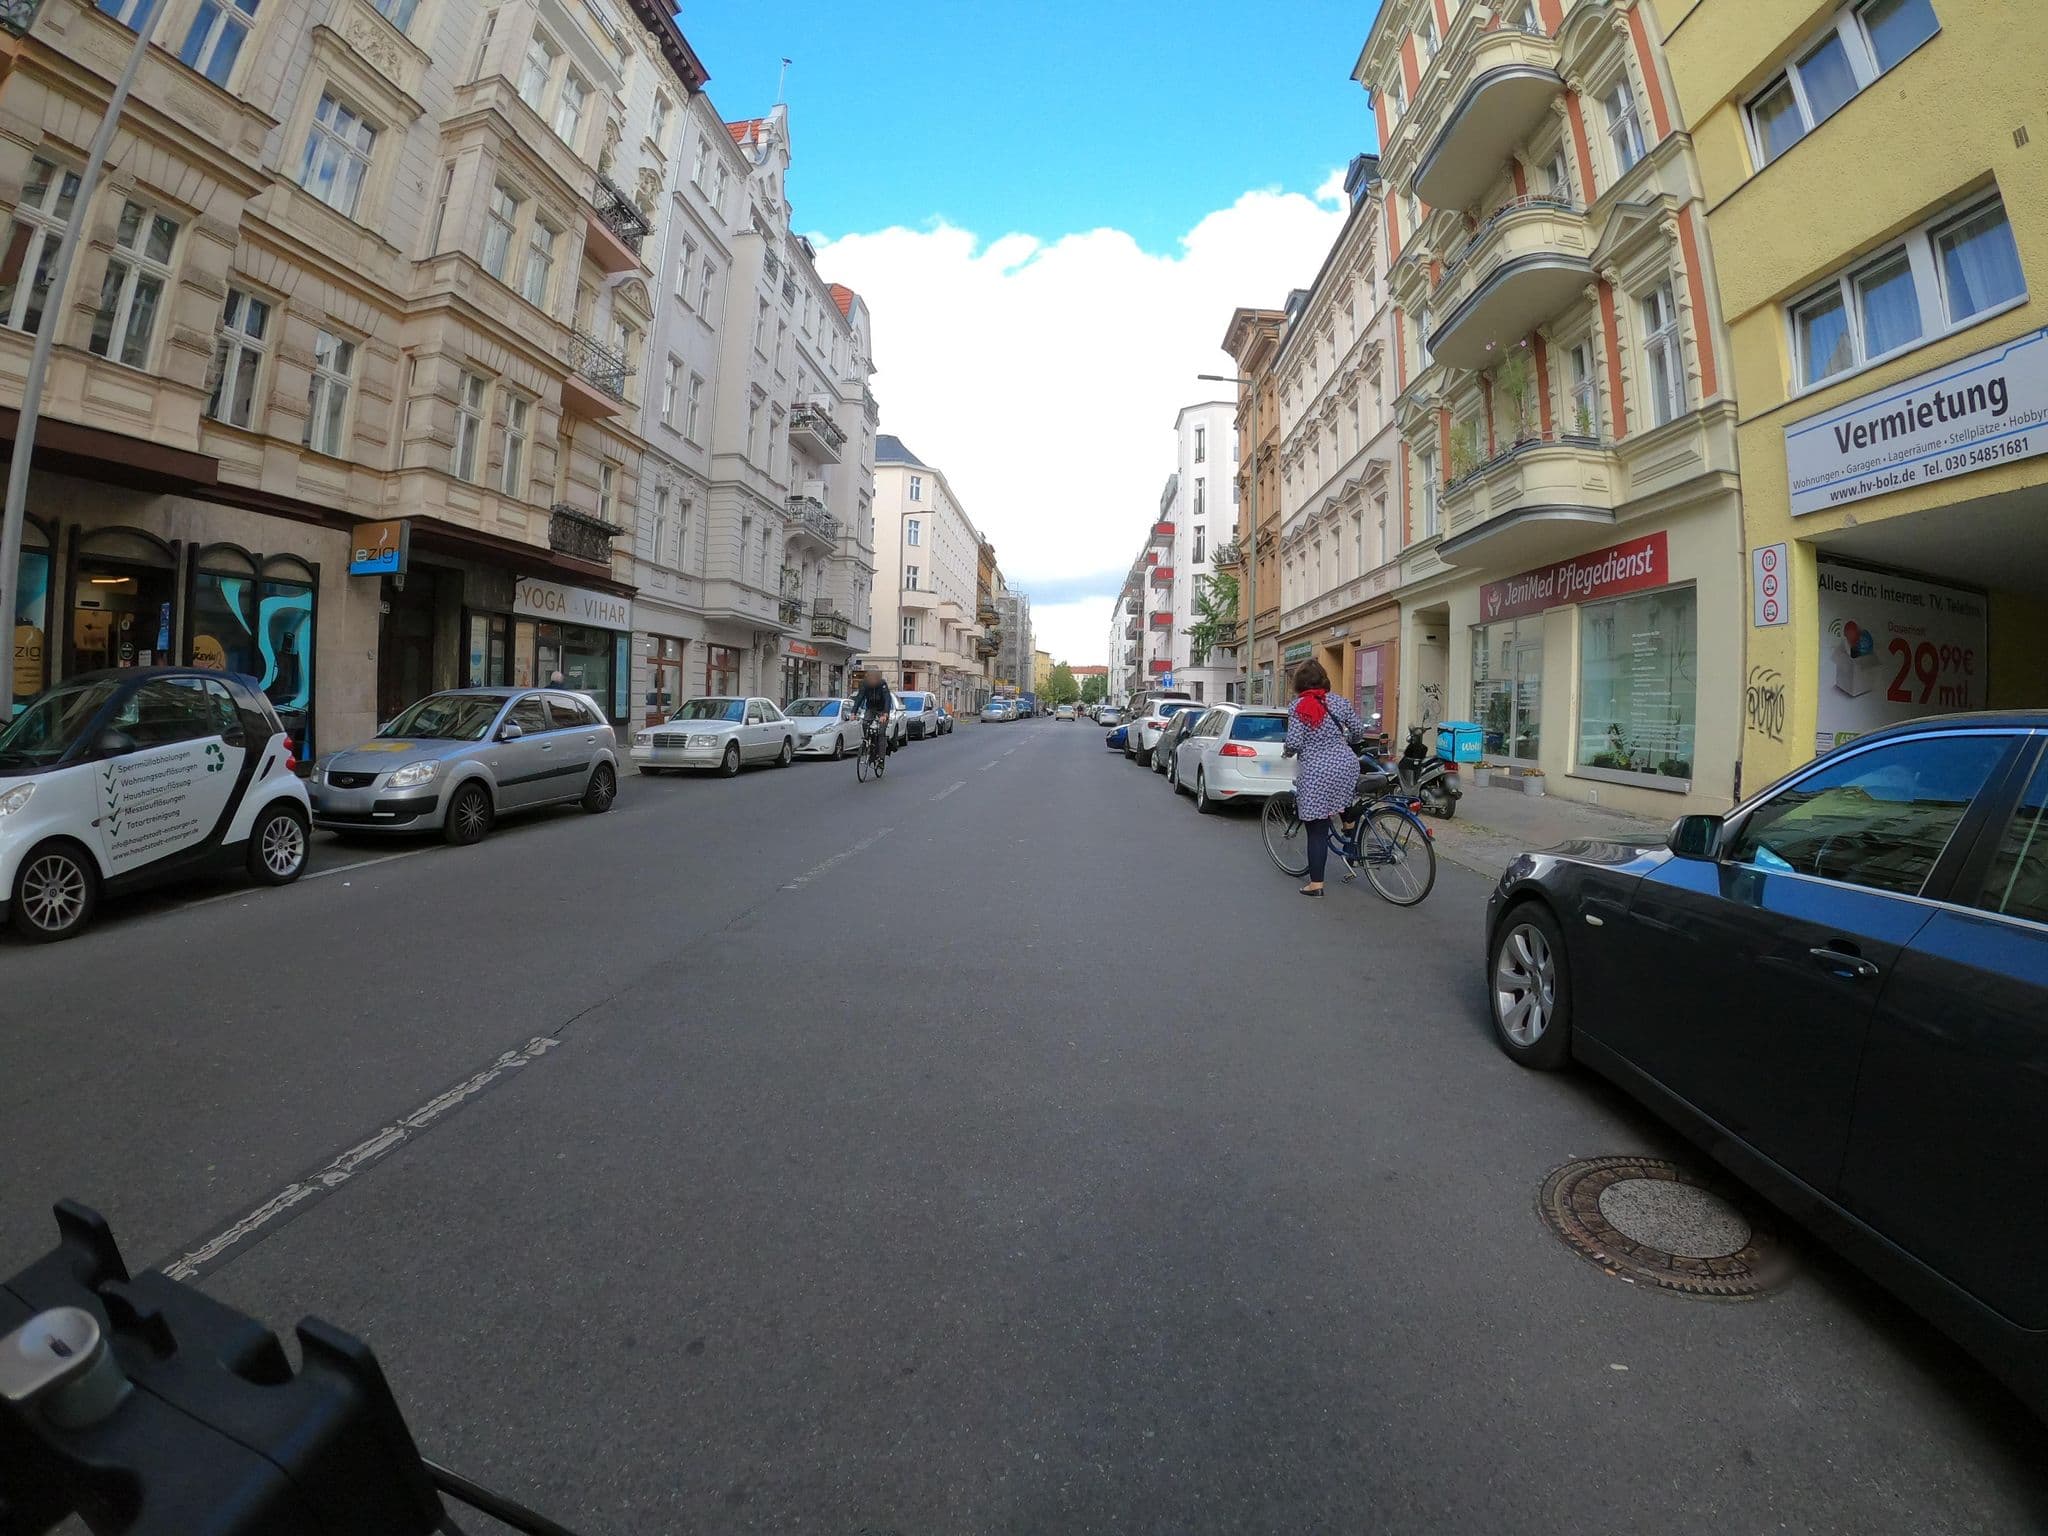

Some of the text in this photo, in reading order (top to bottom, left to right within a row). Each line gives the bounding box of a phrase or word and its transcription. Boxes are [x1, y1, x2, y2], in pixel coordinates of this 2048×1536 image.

[1834, 376, 2009, 455] Vermietung
[1793, 468, 1840, 490] Wohnungen
[1846, 456, 1882, 476] Garagen
[1887, 438, 1942, 464] Lagerräume
[1949, 420, 2001, 445] Stellplätze
[1830, 437, 2029, 501] www.hv-bolz.de Tel. 030 54851681
[356, 546, 395, 564] ezig
[1505, 544, 1654, 606] JeniMed Pflegedienst
[1818, 573, 1848, 593] Alles
[1851, 581, 1877, 598] drin:
[521, 585, 625, 624] YOGA VIHAR
[1887, 637, 1939, 705] 29
[127, 809, 181, 829] Tatortreinigung
